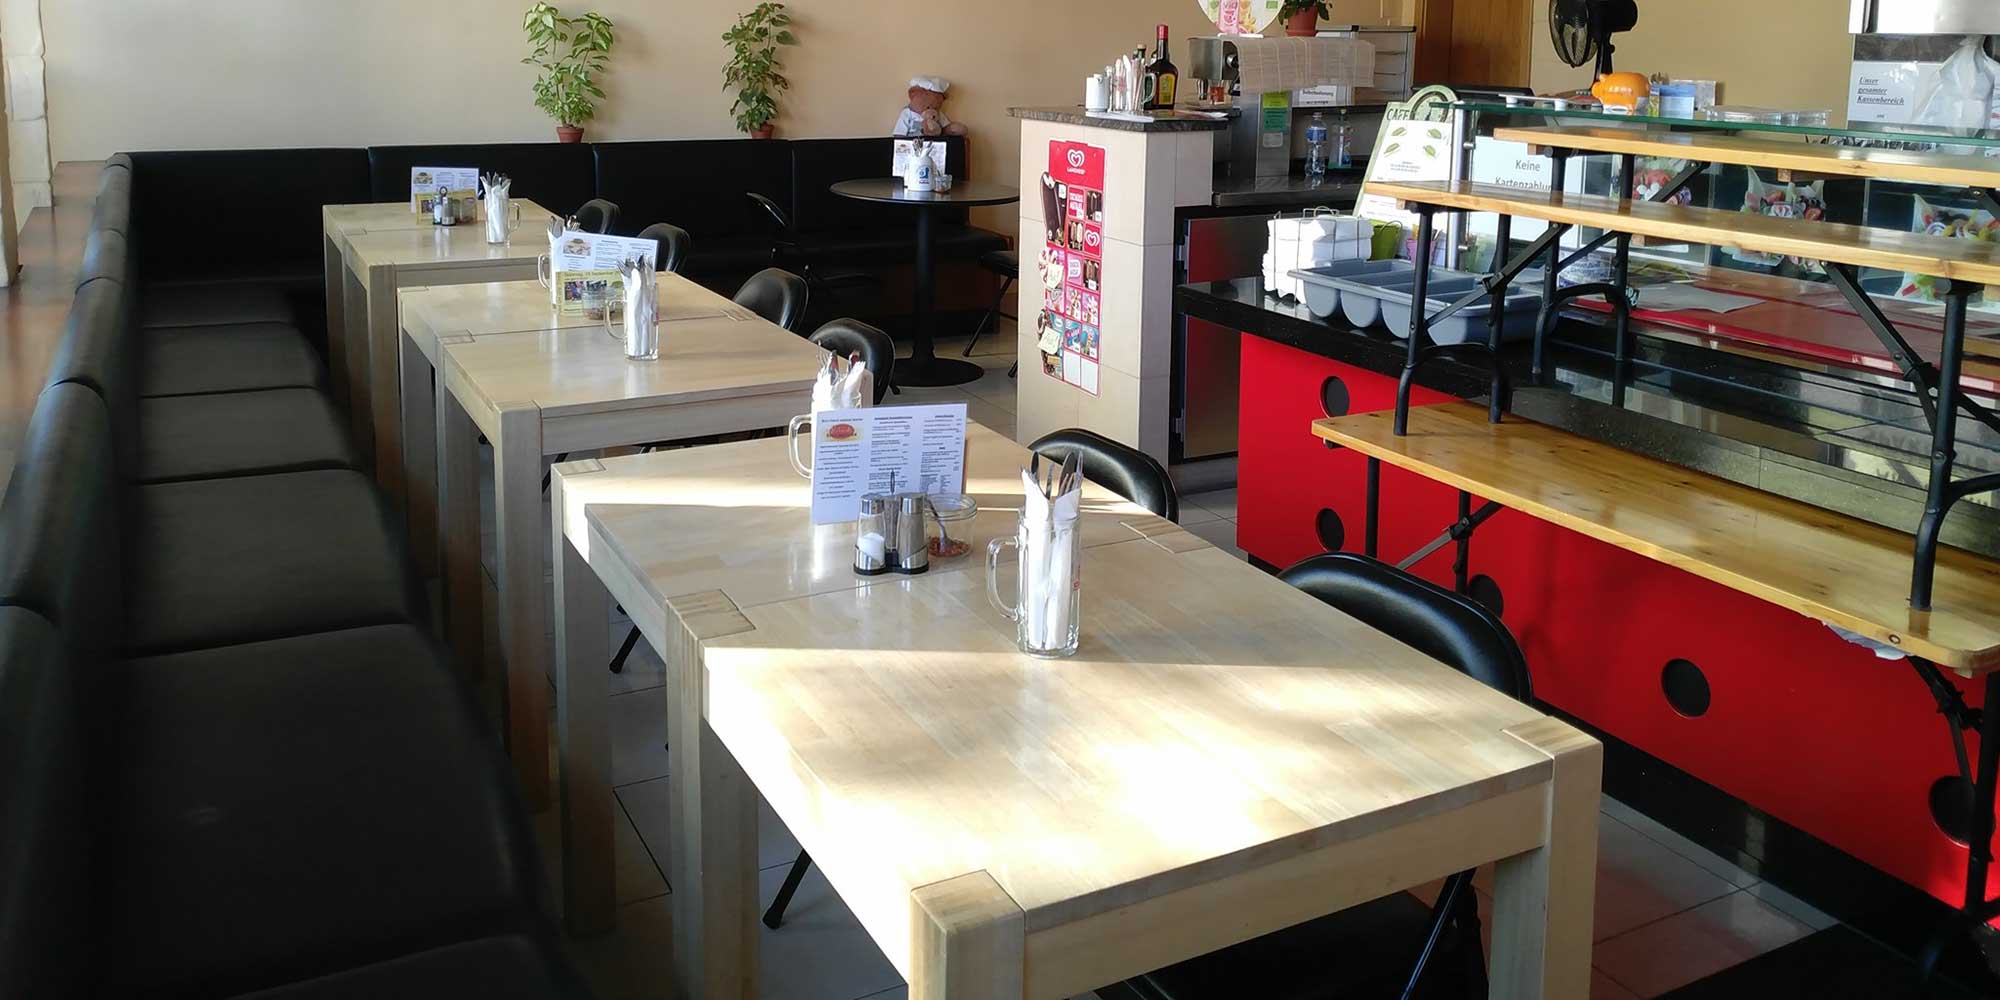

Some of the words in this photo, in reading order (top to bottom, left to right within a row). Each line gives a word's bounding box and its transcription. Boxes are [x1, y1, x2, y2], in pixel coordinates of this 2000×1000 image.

[1859, 76, 1880, 85] Unser
[1856, 96, 1905, 106] Kassenbereich
[1515, 159, 1541, 172] Keine
